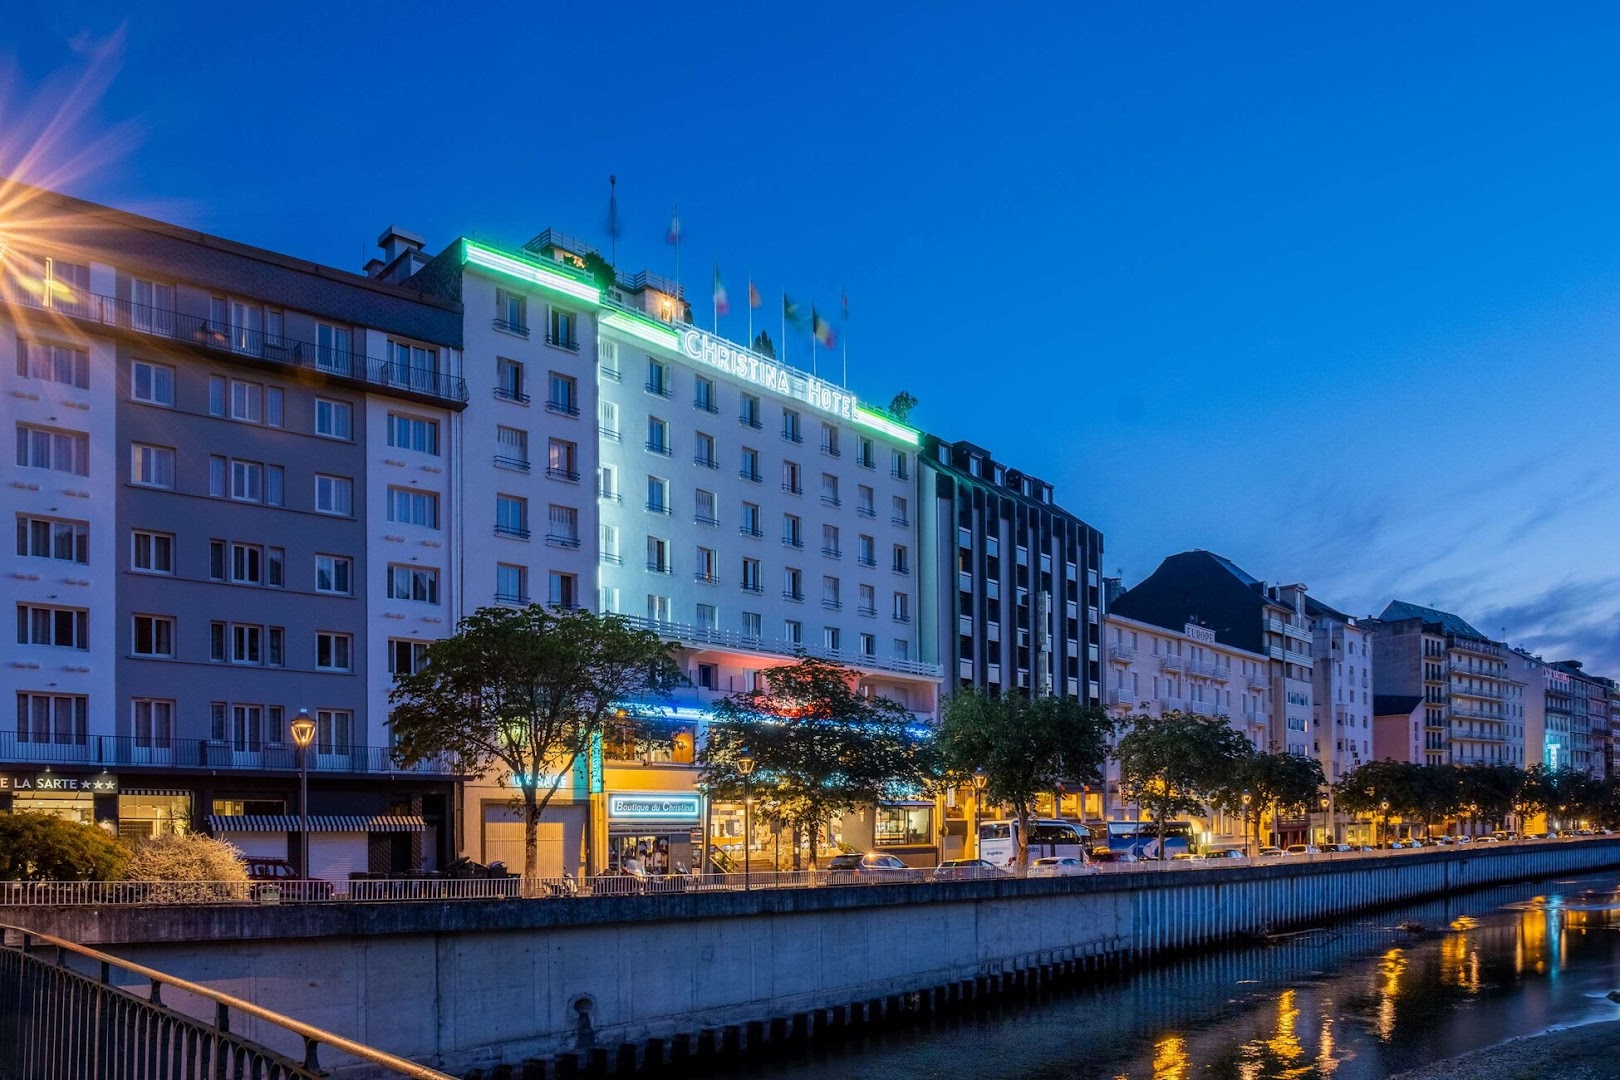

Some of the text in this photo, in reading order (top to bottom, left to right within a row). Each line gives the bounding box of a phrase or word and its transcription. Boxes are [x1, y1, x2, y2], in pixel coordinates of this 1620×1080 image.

[684, 330, 860, 420] CHRISTINA HOTEL
[1186, 626, 1215, 643] EUROPE
[14, 778, 32, 789] LA
[37, 778, 78, 789] SARTE
[616, 801, 694, 813] Boutique du Christina
